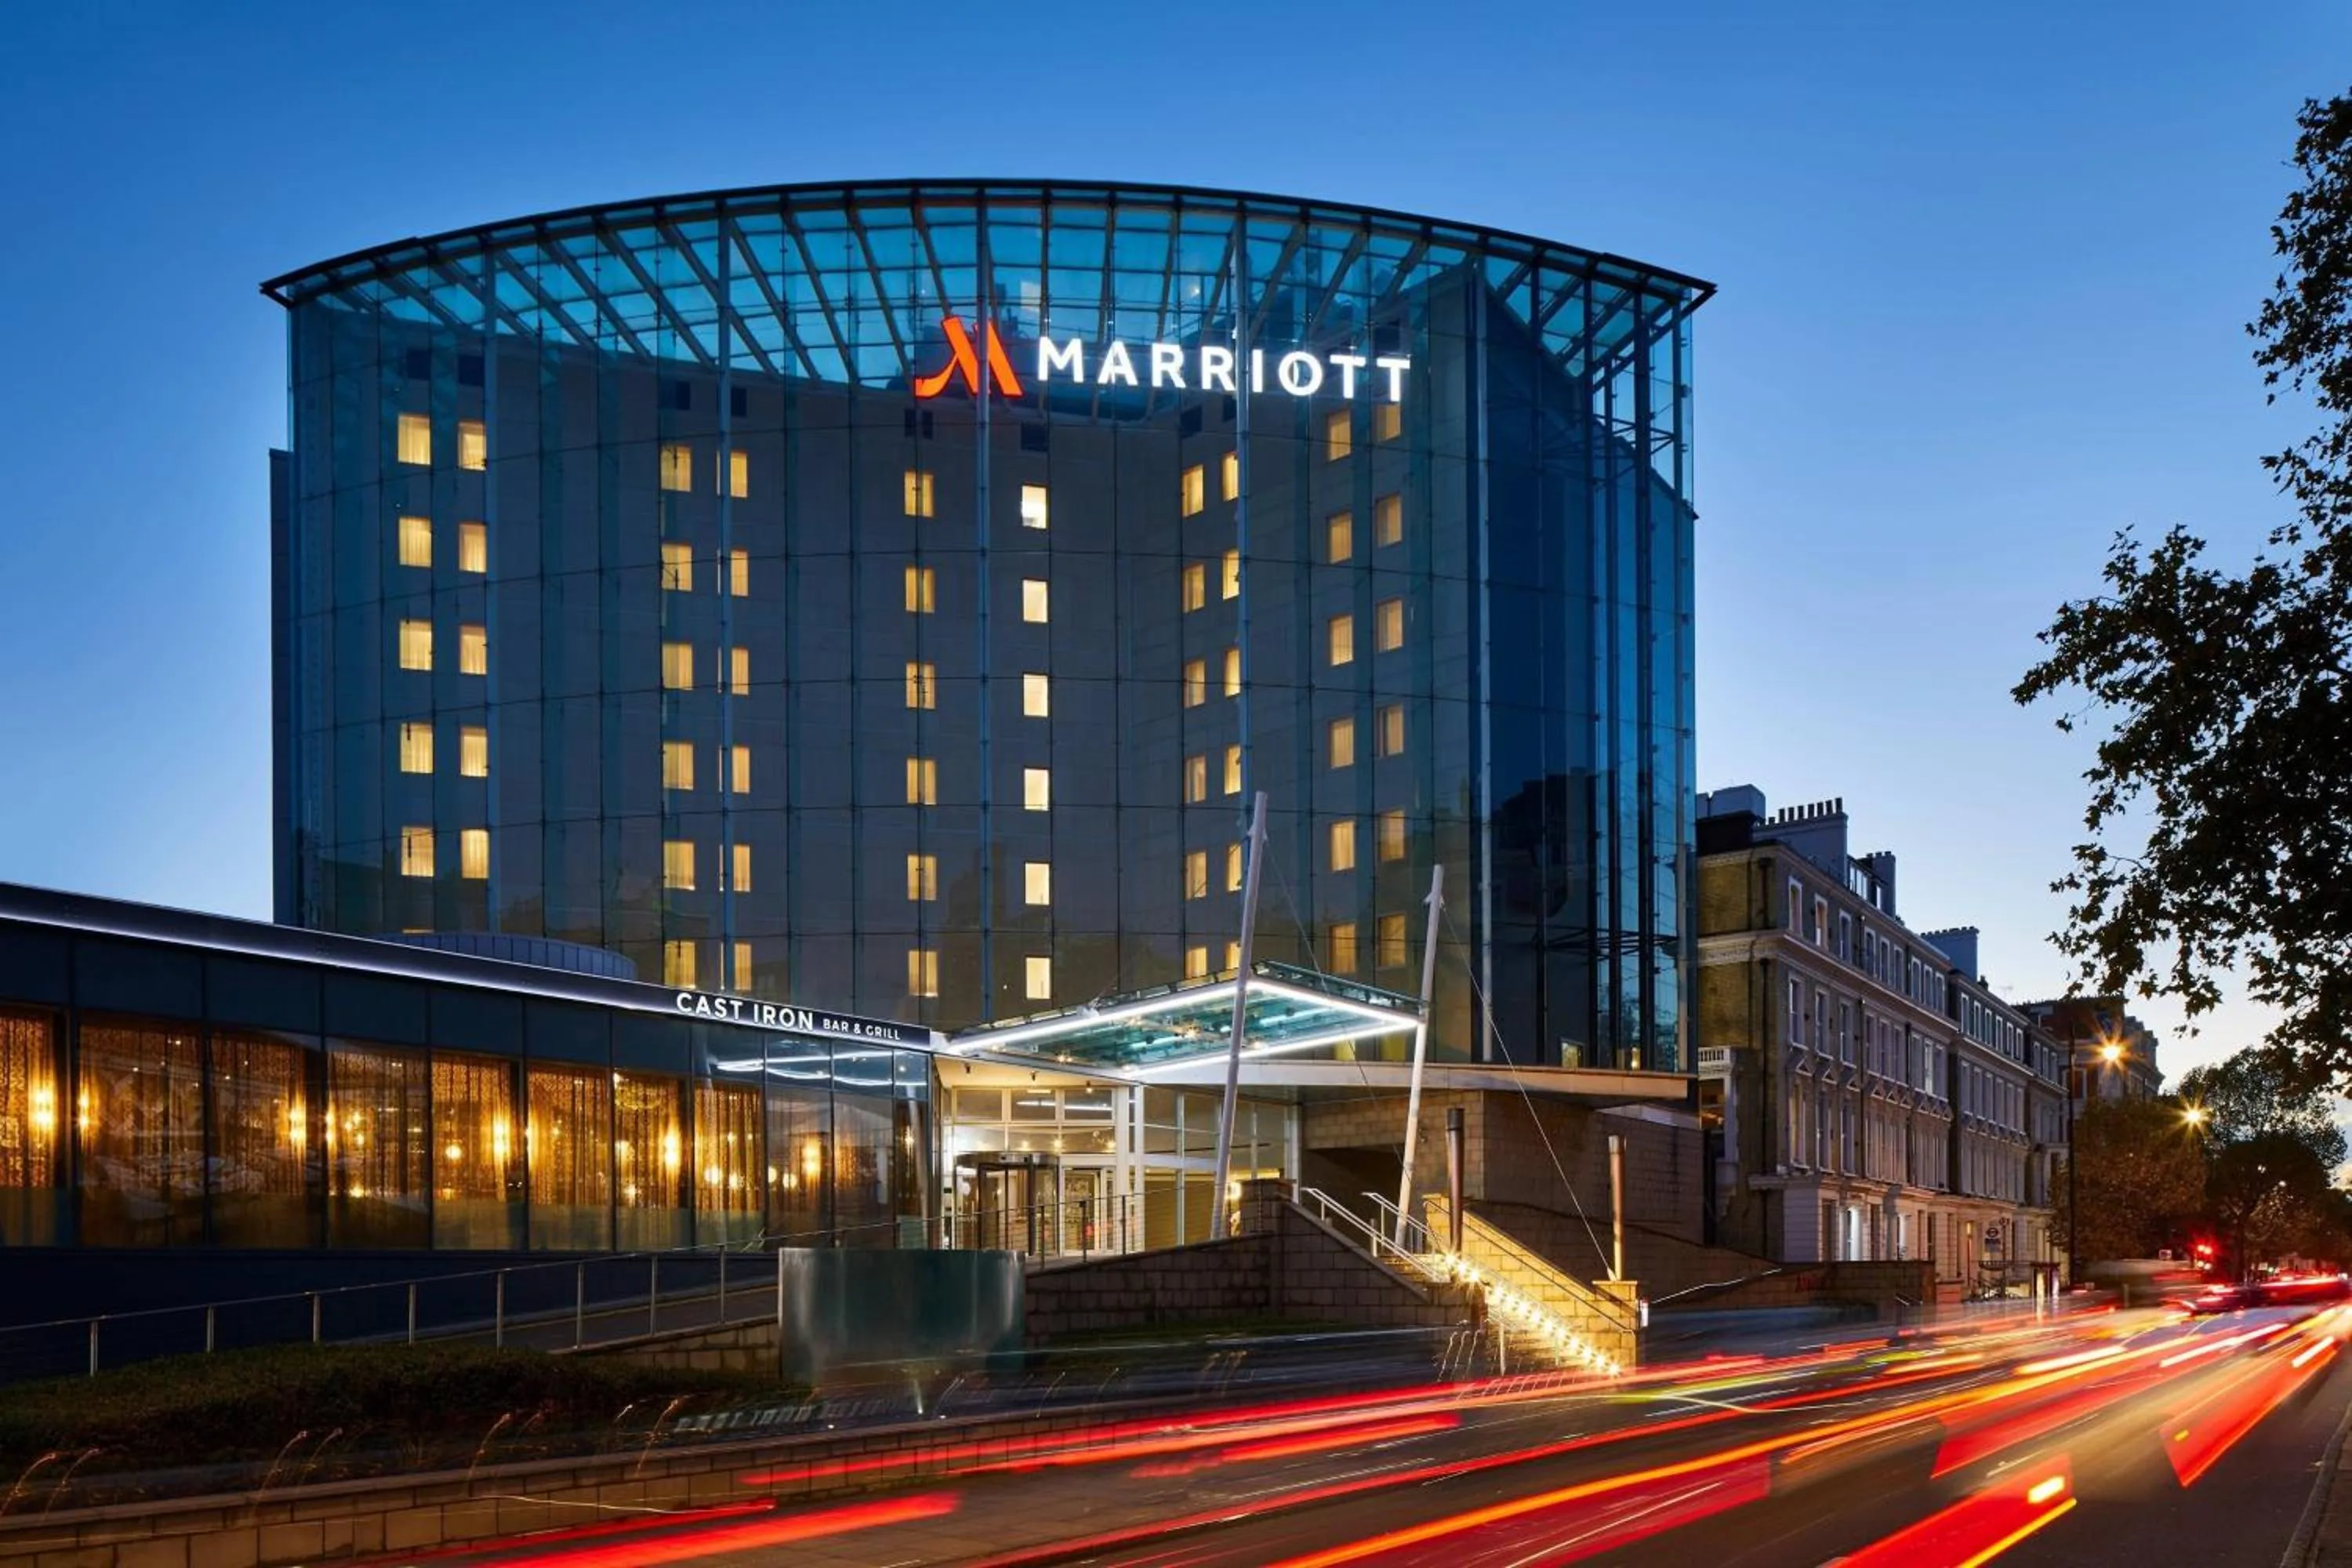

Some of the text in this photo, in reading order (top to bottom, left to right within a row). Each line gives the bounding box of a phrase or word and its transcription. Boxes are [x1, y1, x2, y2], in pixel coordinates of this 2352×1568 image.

[1036, 337, 1410, 401] MARRIOTT
[676, 992, 901, 1040] CAST IRON BAR & GRILL
